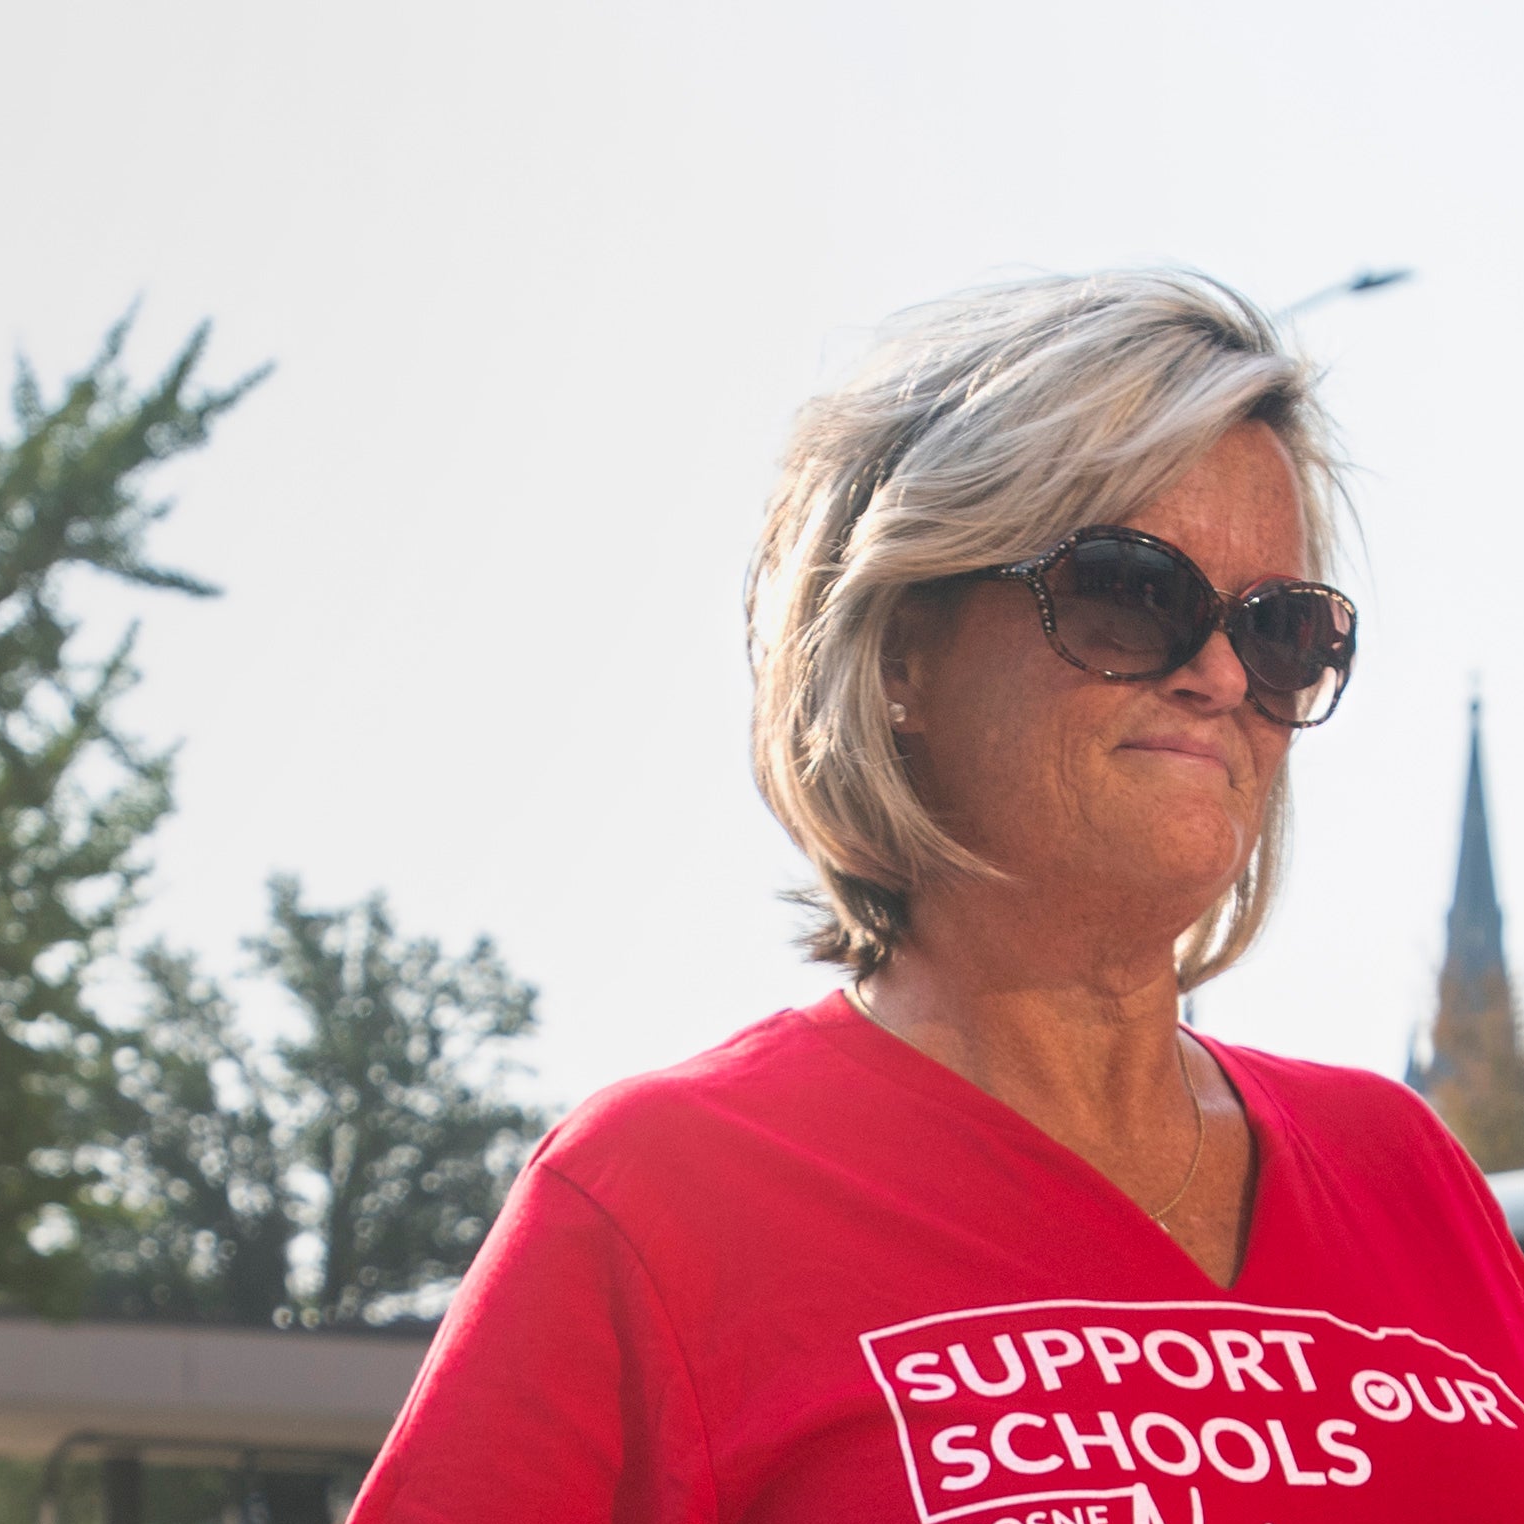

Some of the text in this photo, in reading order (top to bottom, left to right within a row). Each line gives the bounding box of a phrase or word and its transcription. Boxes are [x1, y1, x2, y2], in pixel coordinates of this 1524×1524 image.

[895, 1325, 1518, 1430] SUPPORT OUR
[930, 1410, 1373, 1491] SCHOOLS
